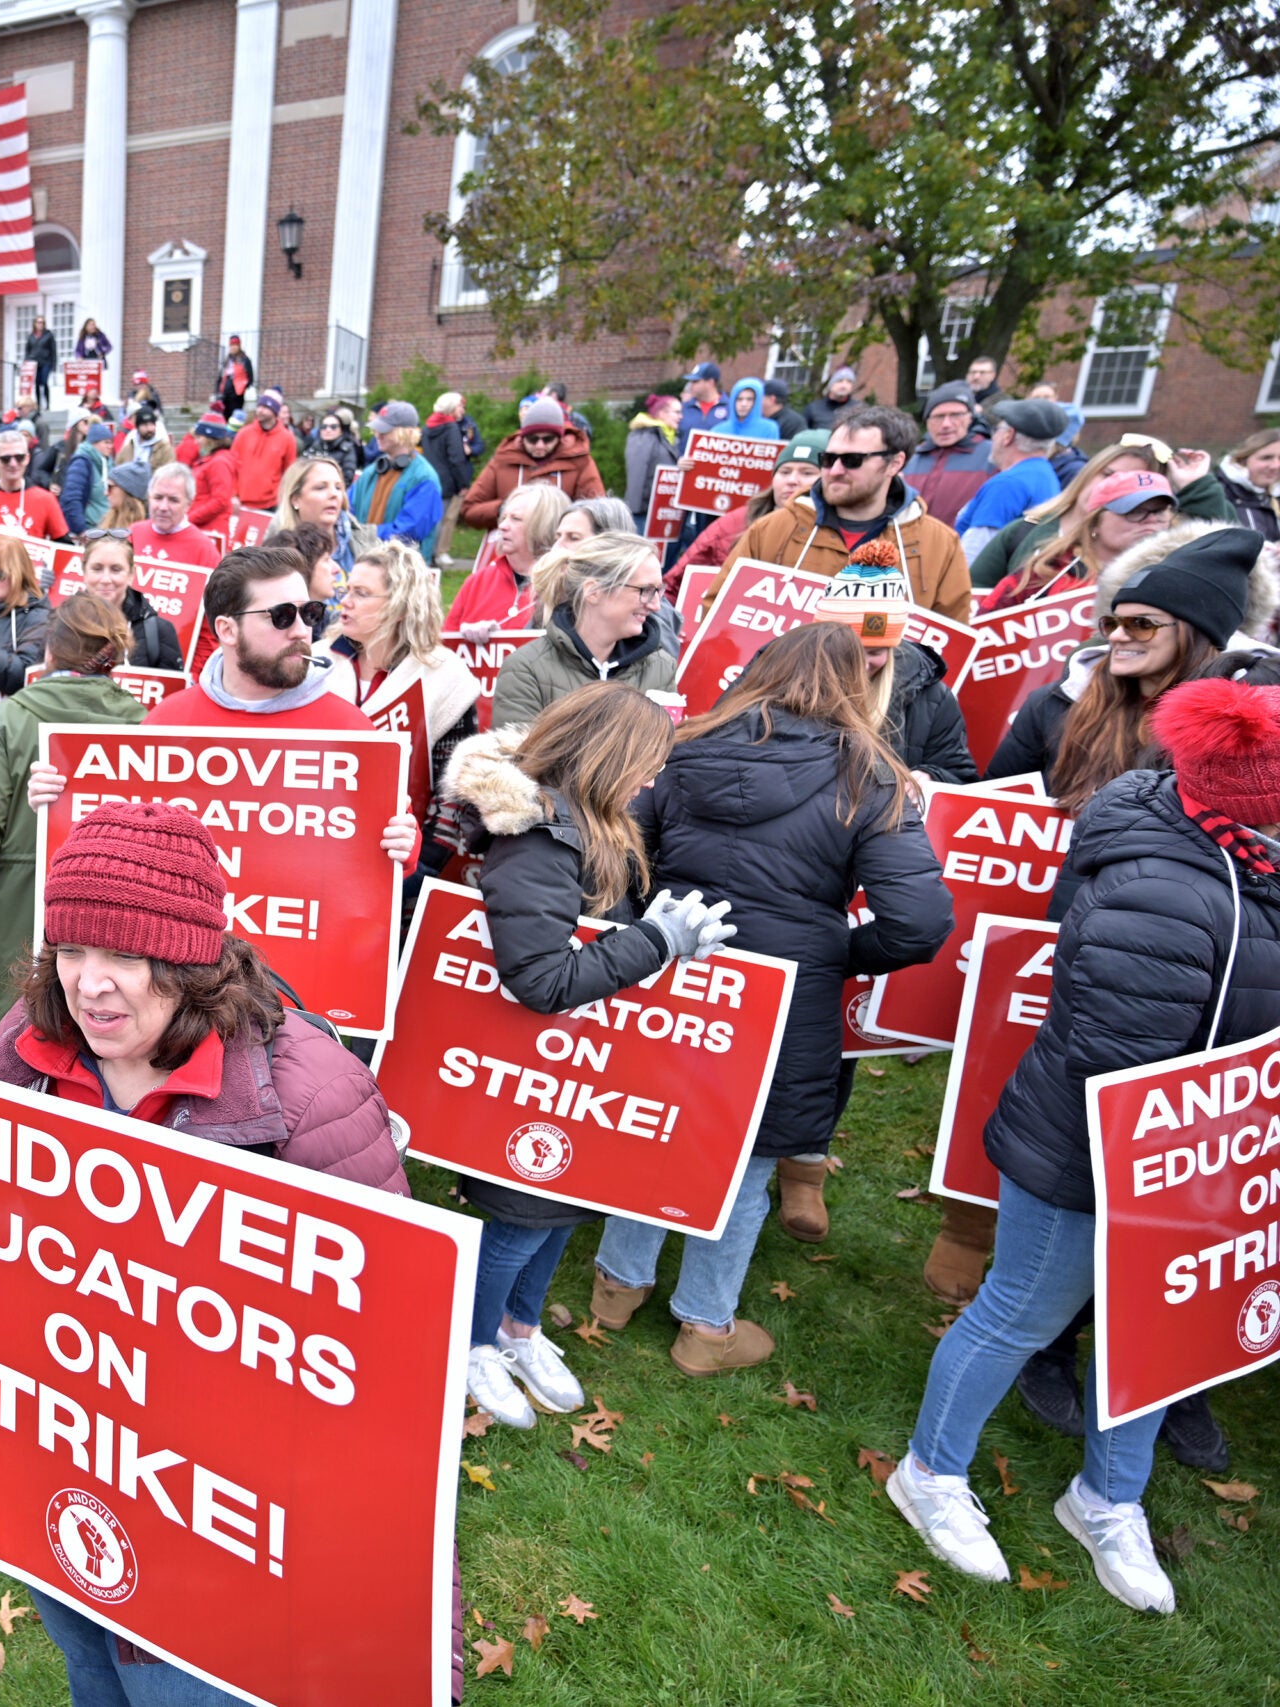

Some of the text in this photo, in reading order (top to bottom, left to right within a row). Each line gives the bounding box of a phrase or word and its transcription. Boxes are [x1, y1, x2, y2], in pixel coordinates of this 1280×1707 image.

[692, 450, 774, 471] EDUCATORS
[696, 436, 778, 457] ANDOVER
[694, 476, 760, 497] STRIKE!
[718, 467, 741, 479] ON
[63, 555, 189, 594] AVER
[978, 600, 1095, 649] ANDO
[73, 743, 361, 791] ANDOVER
[71, 793, 357, 839] EATORS
[216, 846, 242, 878] N
[433, 952, 735, 1054] EDATORS
[535, 1028, 613, 1073] ON
[438, 1046, 681, 1144] STRIKE!
[1131, 1049, 1280, 1141] ANDO
[1133, 1113, 1280, 1198] EDUCA
[1163, 1221, 1280, 1305] STRI
[43, 1311, 149, 1407] ON
[67, 1492, 118, 1530] ANDOVER
[53, 1543, 130, 1599] EDUCATION ASSOCIATION
